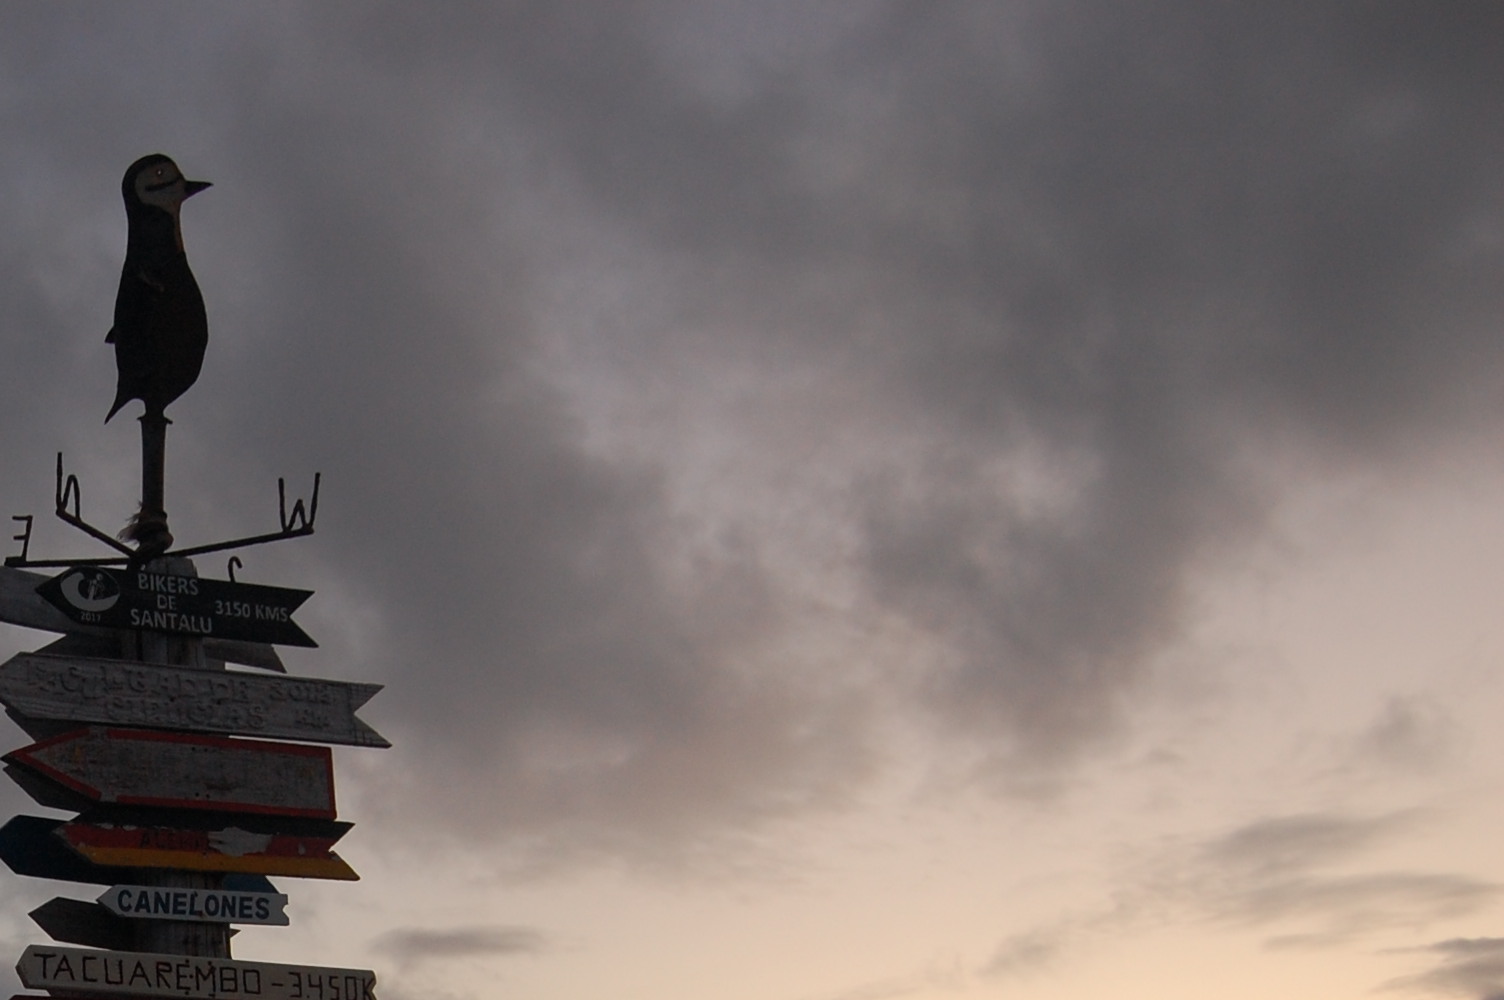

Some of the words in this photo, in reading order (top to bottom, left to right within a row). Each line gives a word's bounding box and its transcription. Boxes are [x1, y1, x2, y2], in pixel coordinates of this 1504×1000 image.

[137, 573, 200, 596] BIKERS
[156, 595, 177, 611] DE
[215, 599, 251, 619] 3150
[255, 603, 289, 623] KMS
[80, 611, 102, 623] 2017
[130, 608, 213, 634] SANTALU
[117, 888, 270, 920] CANELONES
[34, 952, 262, 997] TACUAREMBO
